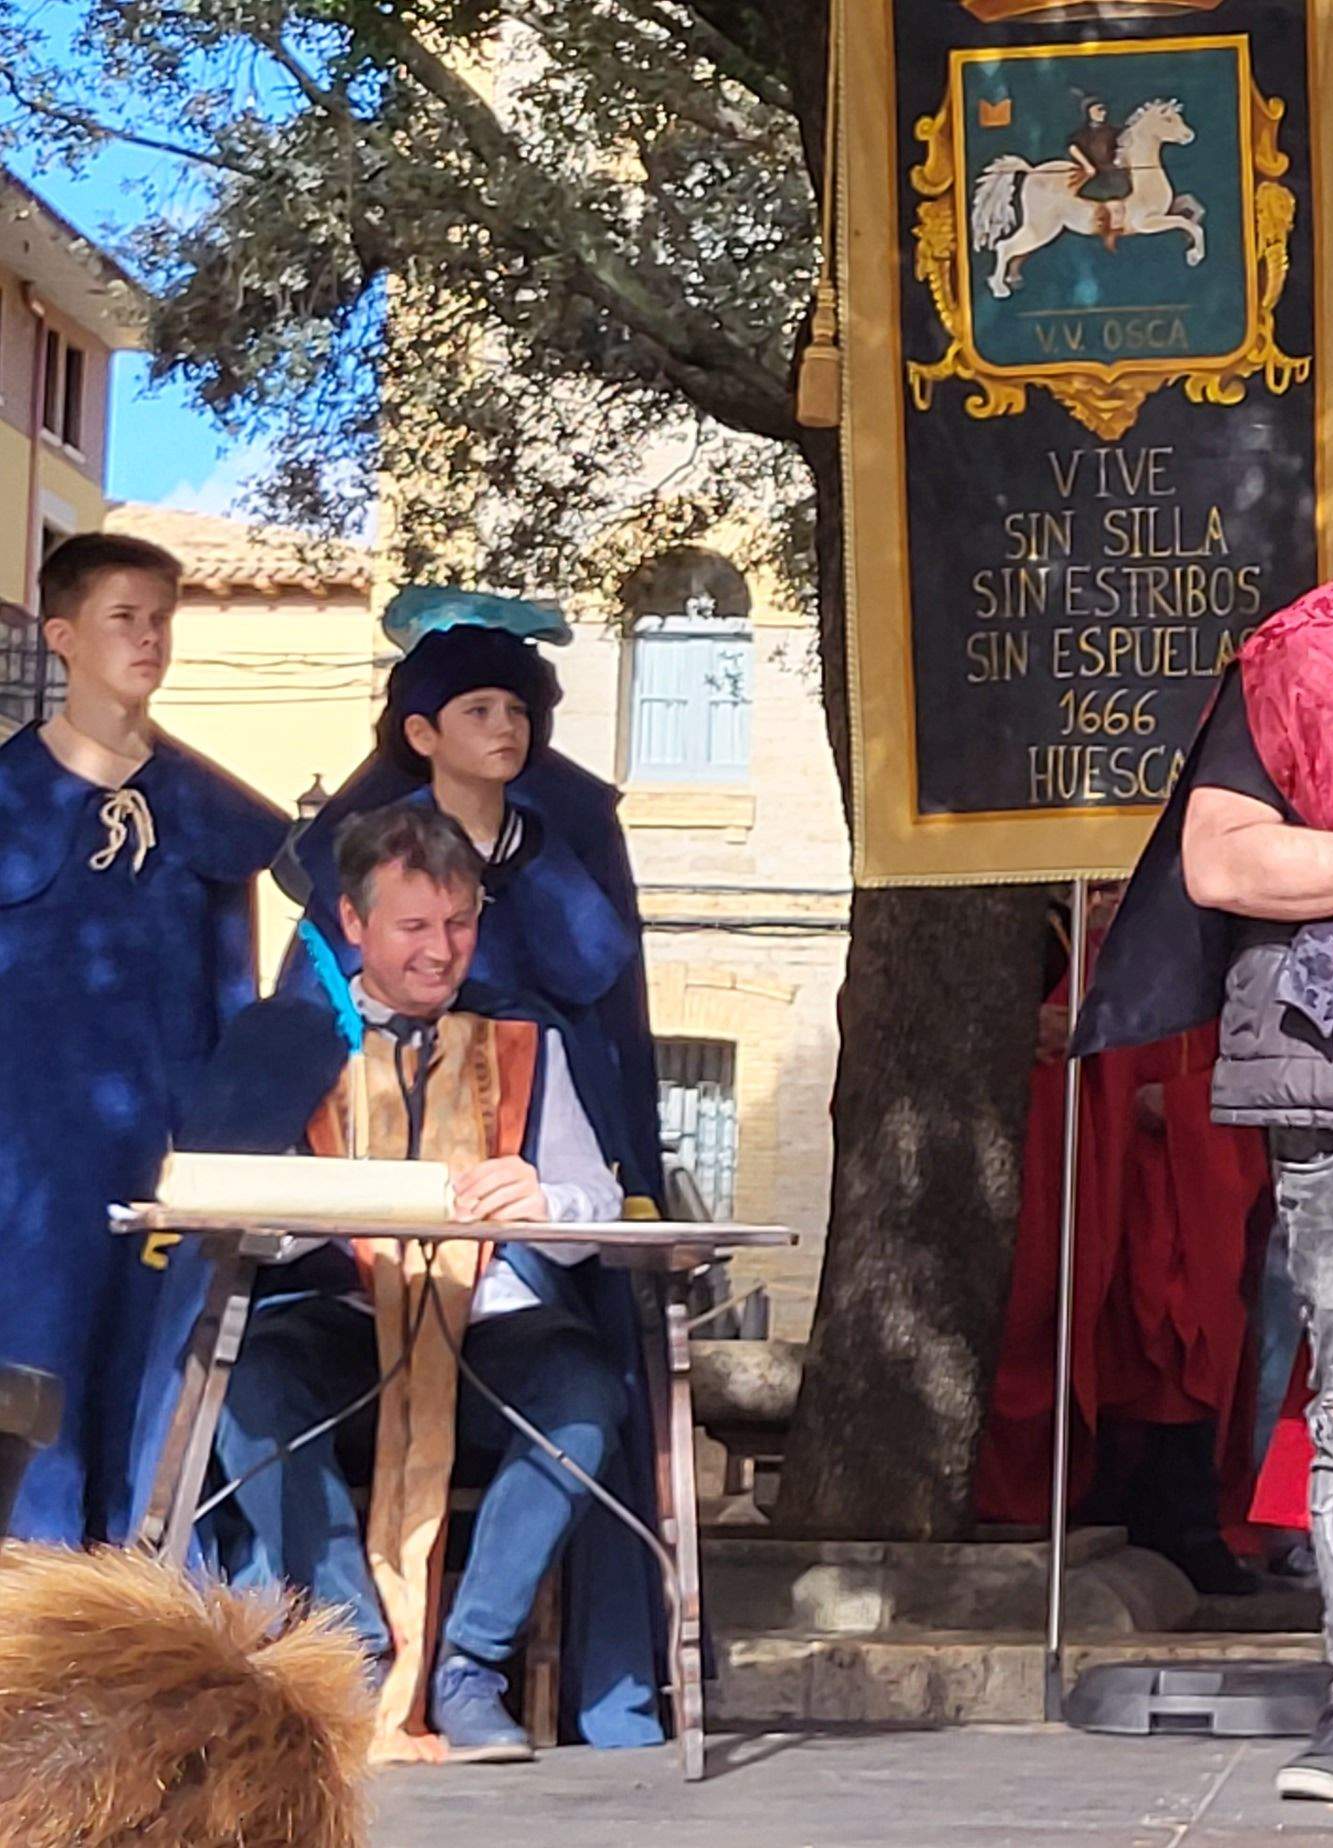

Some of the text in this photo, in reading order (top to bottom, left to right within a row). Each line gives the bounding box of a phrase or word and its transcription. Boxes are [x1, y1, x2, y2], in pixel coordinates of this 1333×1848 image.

[1103, 318, 1189, 351] OSCA
[1049, 446, 1176, 498] VIVE
[1004, 505, 1229, 561] SIN SILLA
[972, 564, 1262, 619] SIN ESTRIBOS
[966, 631, 1030, 682] SIN
[1059, 688, 1159, 736] 1666
